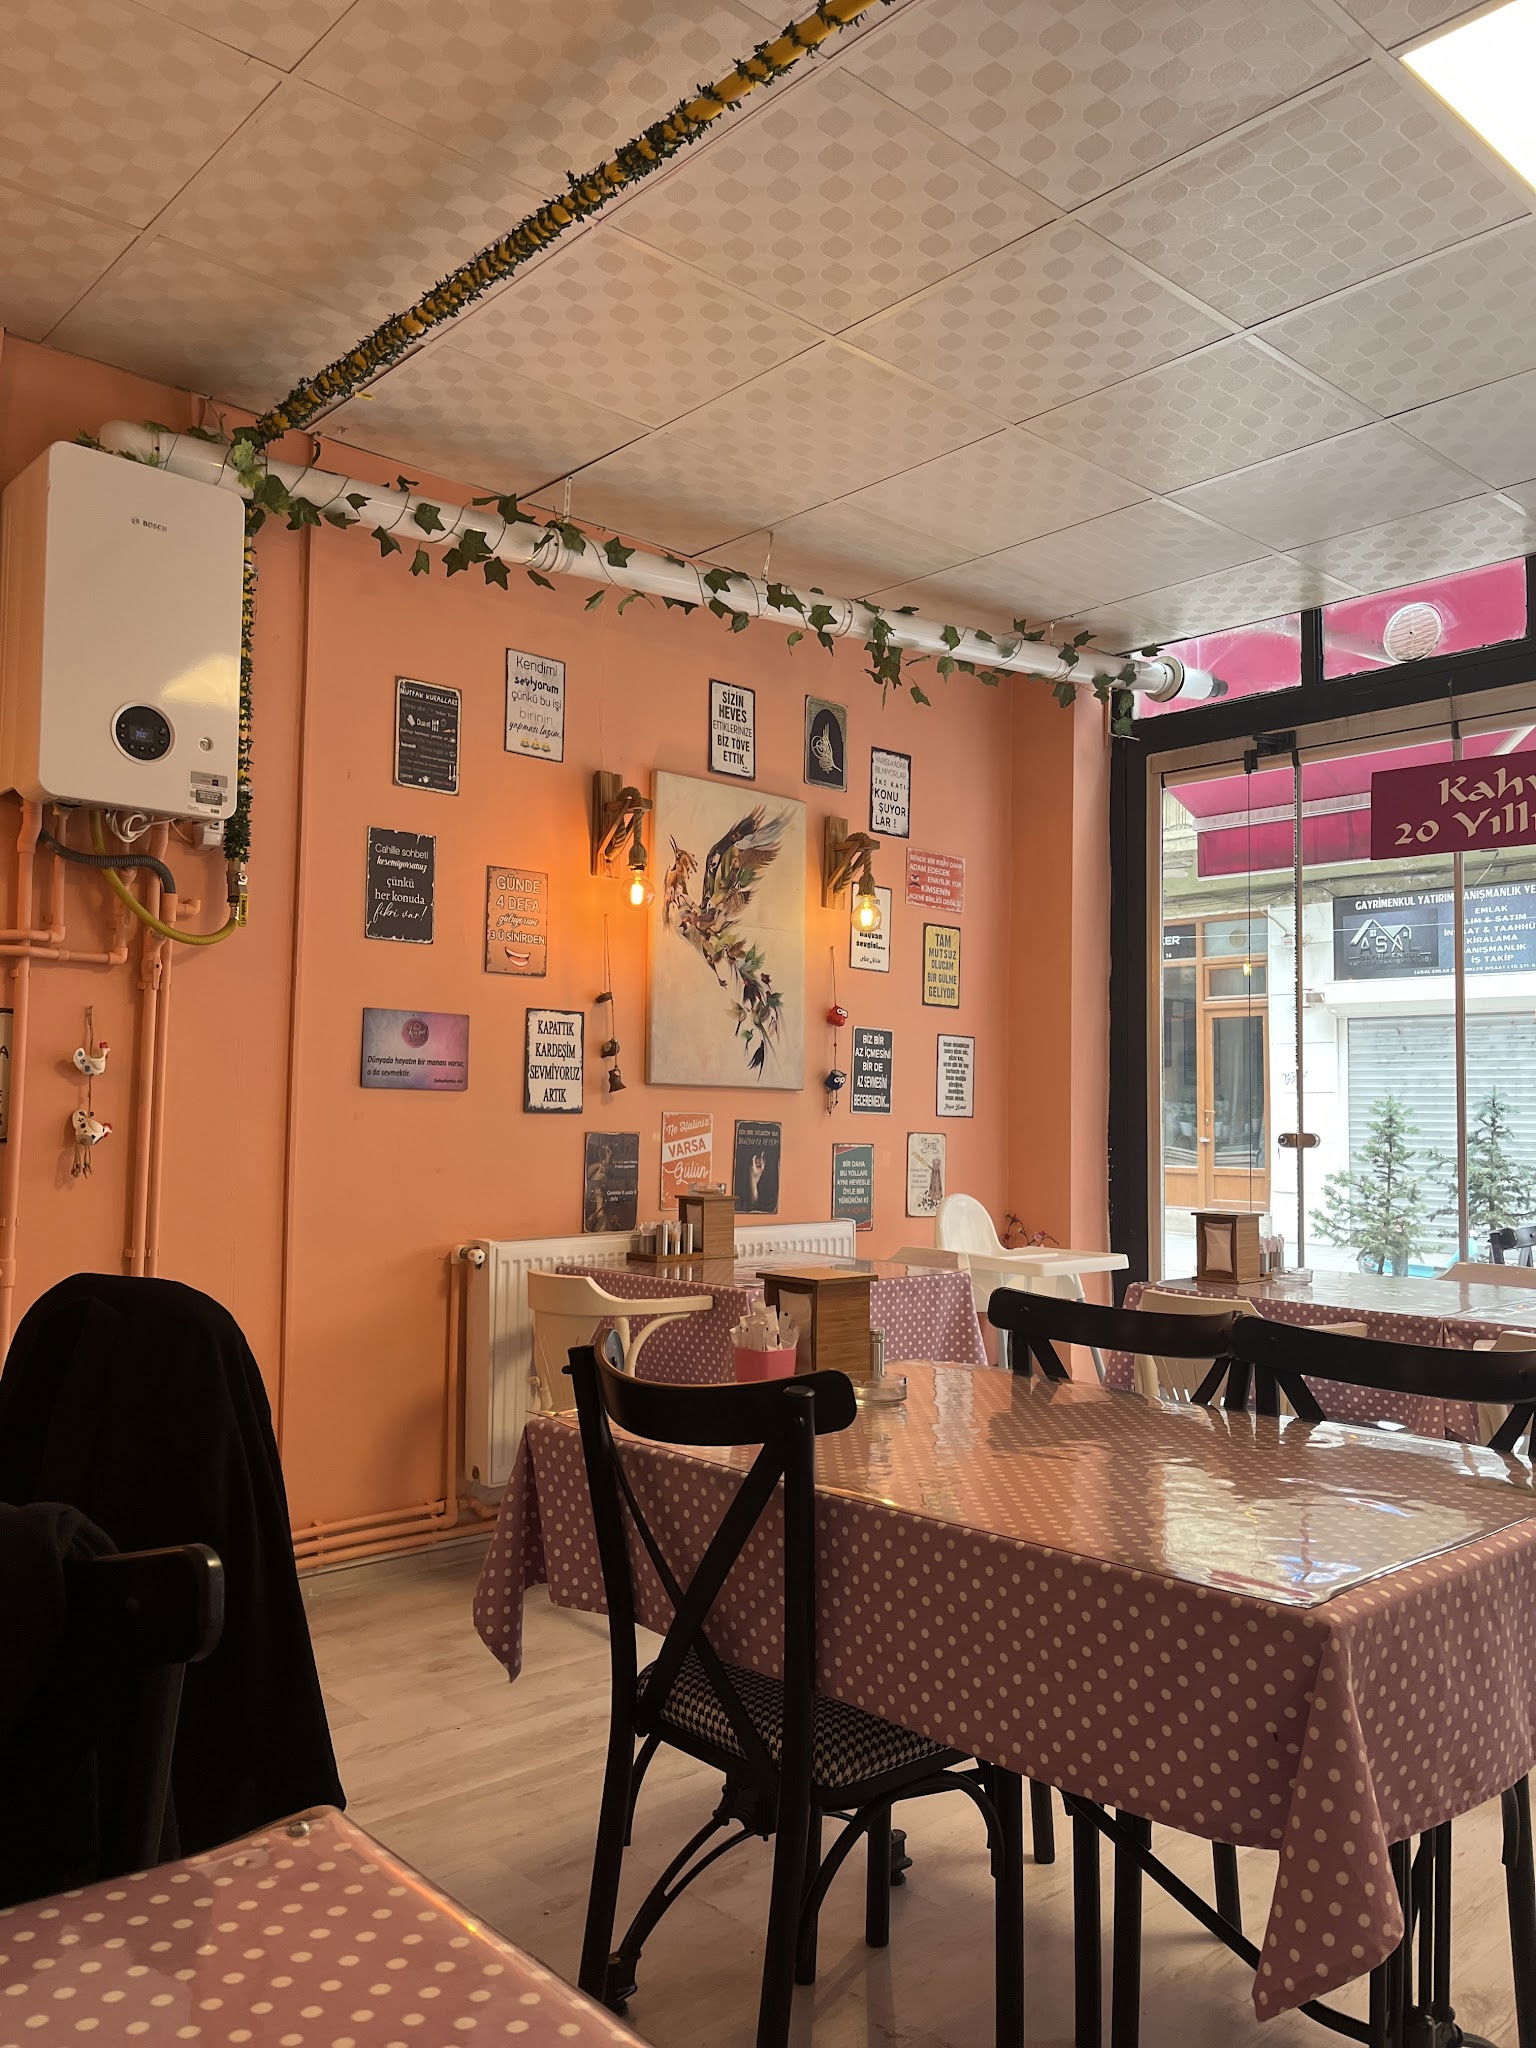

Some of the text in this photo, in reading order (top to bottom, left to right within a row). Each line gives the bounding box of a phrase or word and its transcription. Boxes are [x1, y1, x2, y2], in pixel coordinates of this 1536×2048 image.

[516, 655, 558, 676] Kendimi
[514, 676, 560, 695] seviyorum
[511, 690, 539, 704] çünkü
[539, 696, 551, 707] bu
[722, 690, 744, 709] SİZİN
[519, 707, 553, 724] birinin
[718, 703, 747, 724] HEVES
[874, 787, 899, 802] KONU
[878, 802, 906, 817] ŞUYOR
[875, 815, 891, 828] LAR
[1394, 801, 1536, 846] 20 Yıll
[401, 848, 429, 860] sohbeti
[386, 877, 415, 889] çünkü
[496, 874, 541, 894] GÜNDE
[375, 888, 426, 905] her konuda
[496, 894, 540, 912] 4 DEFA
[1355, 897, 1415, 911] GAYRİMENKUL
[1418, 892, 1455, 905] YATIRIM
[1463, 885, 1522, 902] ANIŞMANLIK
[1474, 904, 1508, 915] EMLAK
[1463, 913, 1527, 925] LIM & SATIM
[1483, 926, 1490, 934] &
[1494, 921, 1536, 932] TAAHHÜ
[489, 929, 496, 941] 3
[505, 930, 546, 945] SİNİRDEN
[935, 933, 952, 948] TAM
[1466, 933, 1519, 945] KİRALAMA
[928, 947, 957, 961] MUTSUZ
[1464, 943, 1527, 955] ANIŞMANLIK
[1471, 954, 1514, 965] İŞ TAKİP
[862, 1033, 885, 1046] BİZ BİR
[535, 1041, 576, 1061] KARDEŞİM
[854, 1047, 864, 1058] AZ
[529, 1063, 580, 1081] SEVMİYORUZ
[862, 1060, 883, 1073] BİR DE
[543, 1087, 567, 1103] ARTIK
[665, 1124, 679, 1137] Ne
[668, 1137, 707, 1158] VARSA
[663, 1161, 709, 1186] Gülün
